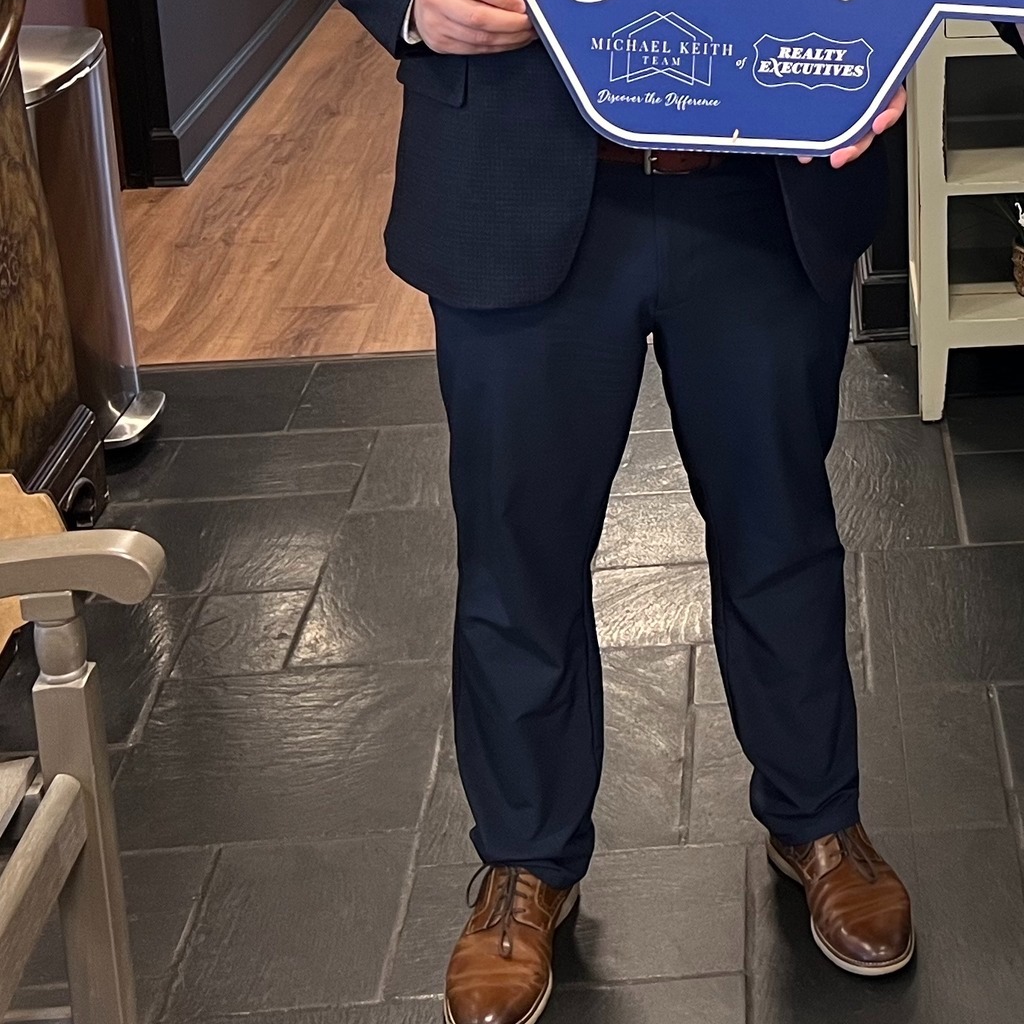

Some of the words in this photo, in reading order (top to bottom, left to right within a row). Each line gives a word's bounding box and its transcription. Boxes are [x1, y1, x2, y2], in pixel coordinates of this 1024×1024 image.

[591, 37, 671, 54] MICHAEL
[680, 41, 733, 56] KEITH
[777, 46, 847, 62] REALTY
[642, 55, 681, 66] TEAM
[736, 57, 748, 69] of
[758, 58, 864, 78] EXECUTIVES
[597, 89, 643, 104] Discover
[644, 91, 662, 105] the
[665, 91, 720, 111] Difference
